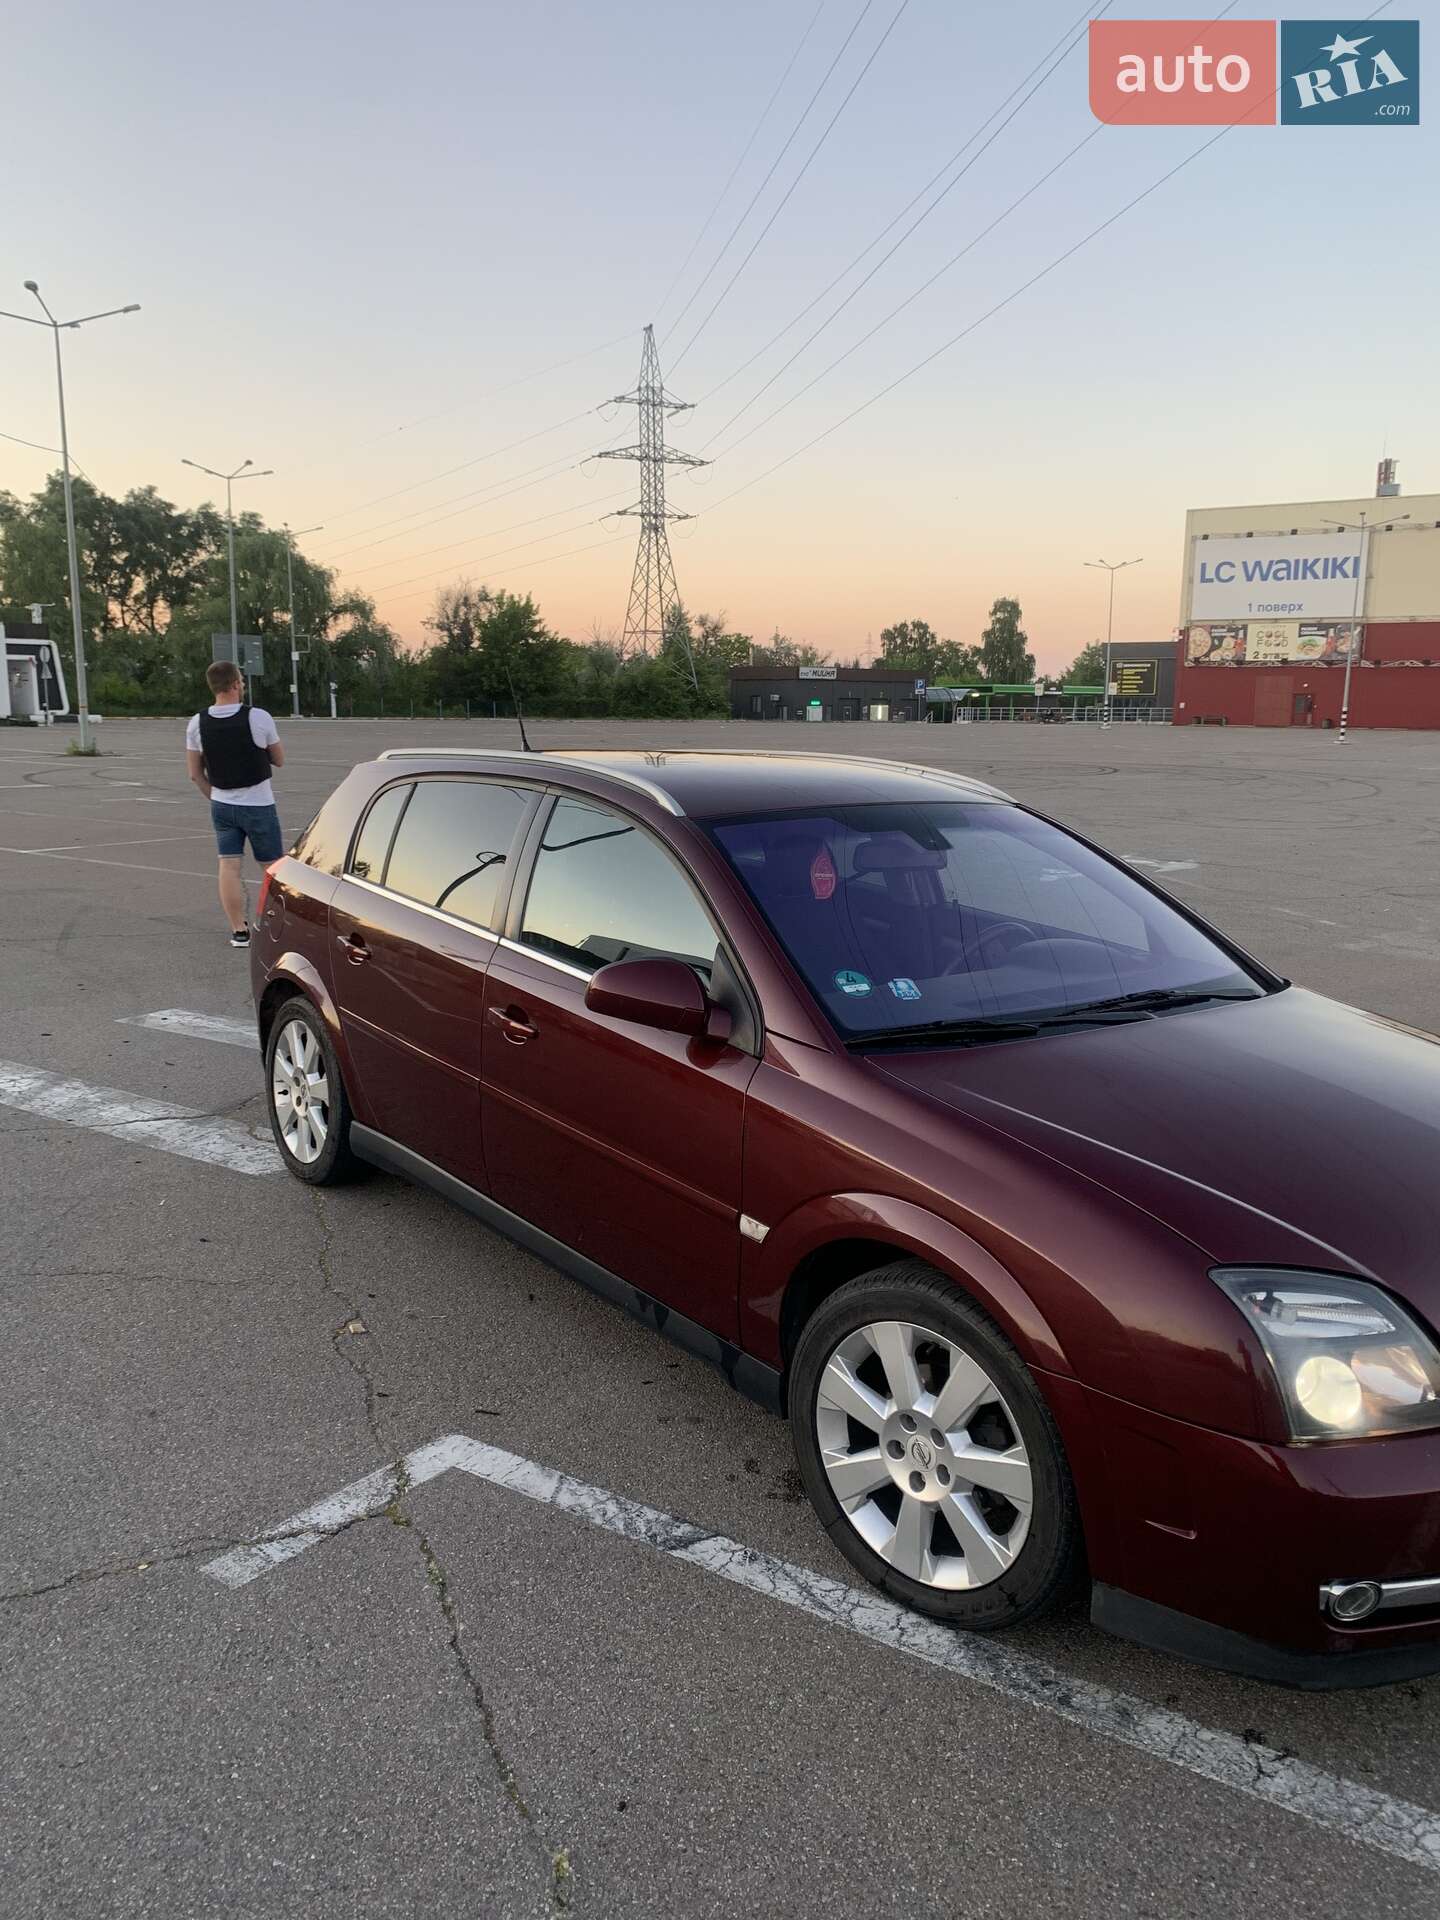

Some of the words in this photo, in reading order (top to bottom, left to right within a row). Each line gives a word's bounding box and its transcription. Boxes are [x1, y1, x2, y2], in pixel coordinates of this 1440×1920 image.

[1200, 561, 1236, 583] LC
[1248, 603, 1253, 613] 1
[1257, 602, 1304, 614] поверх
[1252, 650, 1260, 660] 2
[918, 680, 923, 688] P
